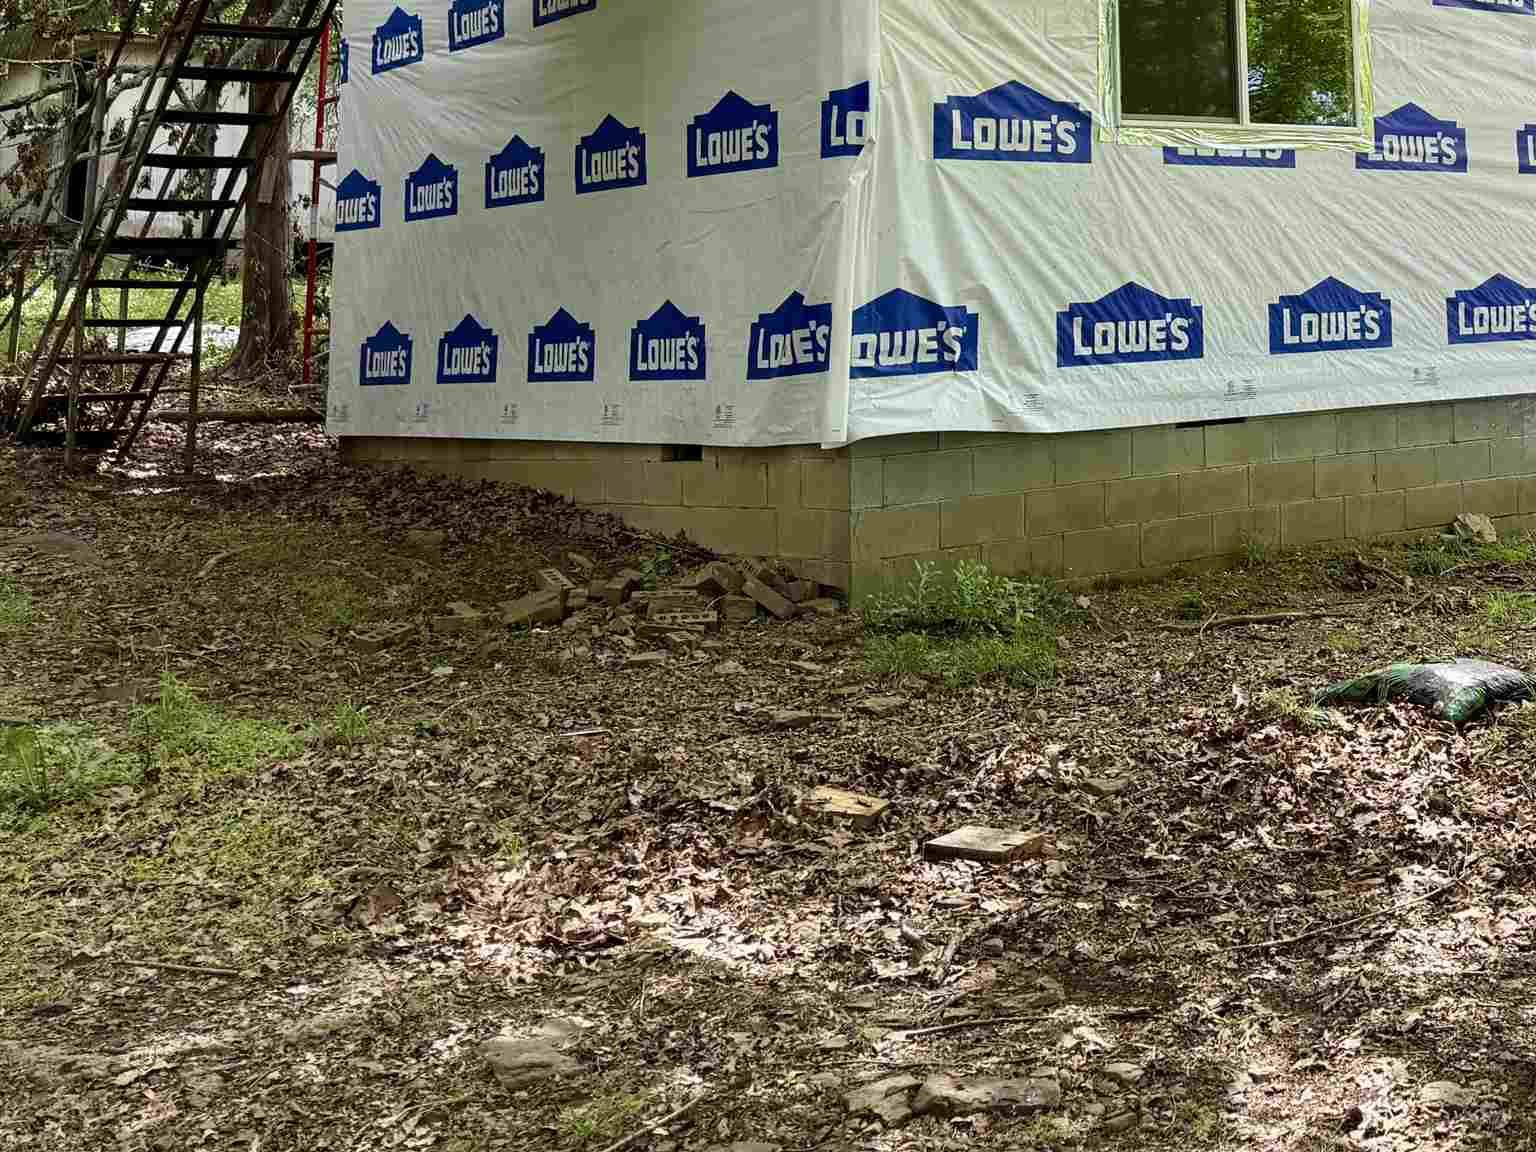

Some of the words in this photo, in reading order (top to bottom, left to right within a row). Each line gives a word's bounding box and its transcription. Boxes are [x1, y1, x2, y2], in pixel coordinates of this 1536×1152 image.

[453, 1, 498, 42] LOWE'S
[376, 26, 417, 65] LOWE'S
[696, 120, 768, 166] LOWE'S
[952, 109, 1077, 154] LOWE'S
[490, 161, 538, 199] LOWE'S
[582, 141, 638, 184] LOWE'S
[336, 192, 376, 224] OWE'S
[410, 177, 452, 213] LOWE'S
[850, 321, 961, 367] OWE'S
[1073, 313, 1190, 356] LOWE'S
[1283, 305, 1380, 345] LOWE'S
[366, 345, 406, 378] LOWE'S
[443, 341, 490, 376] LOWE'S
[535, 336, 588, 373] LOWE'S
[637, 331, 698, 370] LOWE'S
